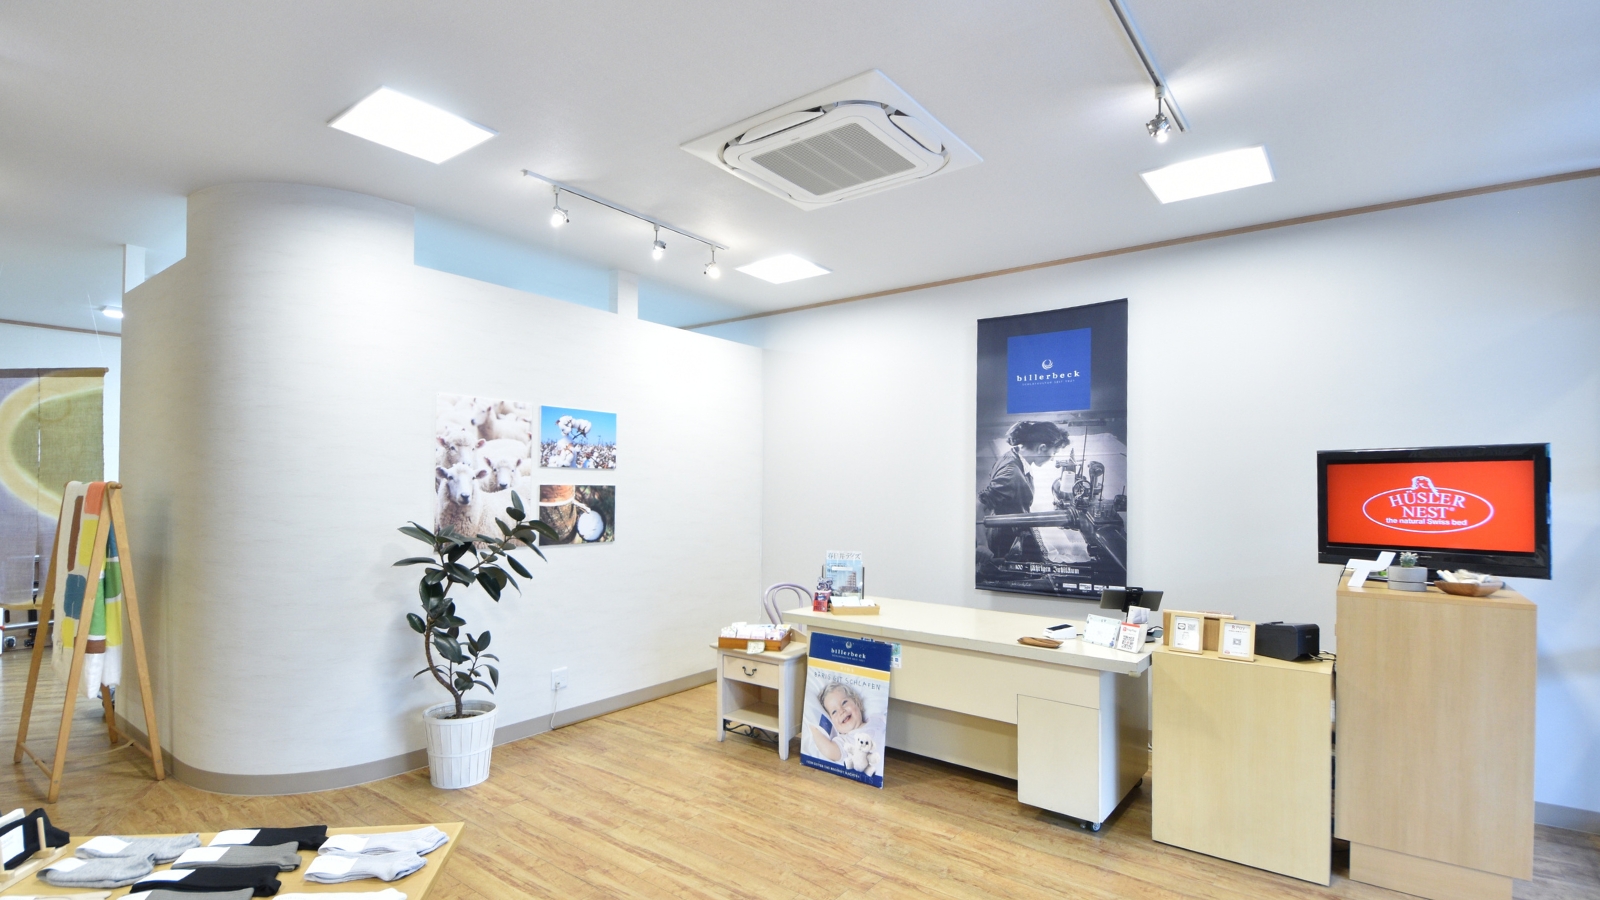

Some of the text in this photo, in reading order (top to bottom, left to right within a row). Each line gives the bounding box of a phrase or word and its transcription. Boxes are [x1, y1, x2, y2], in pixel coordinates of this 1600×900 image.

[1016, 370, 1080, 382] billerbeck
[1388, 490, 1466, 509] HÜSLER
[1427, 518, 1450, 526] Swiss
[1451, 519, 1468, 527] bed
[830, 647, 867, 659] billerbeck
[845, 677, 881, 690] SCHLAFEN
